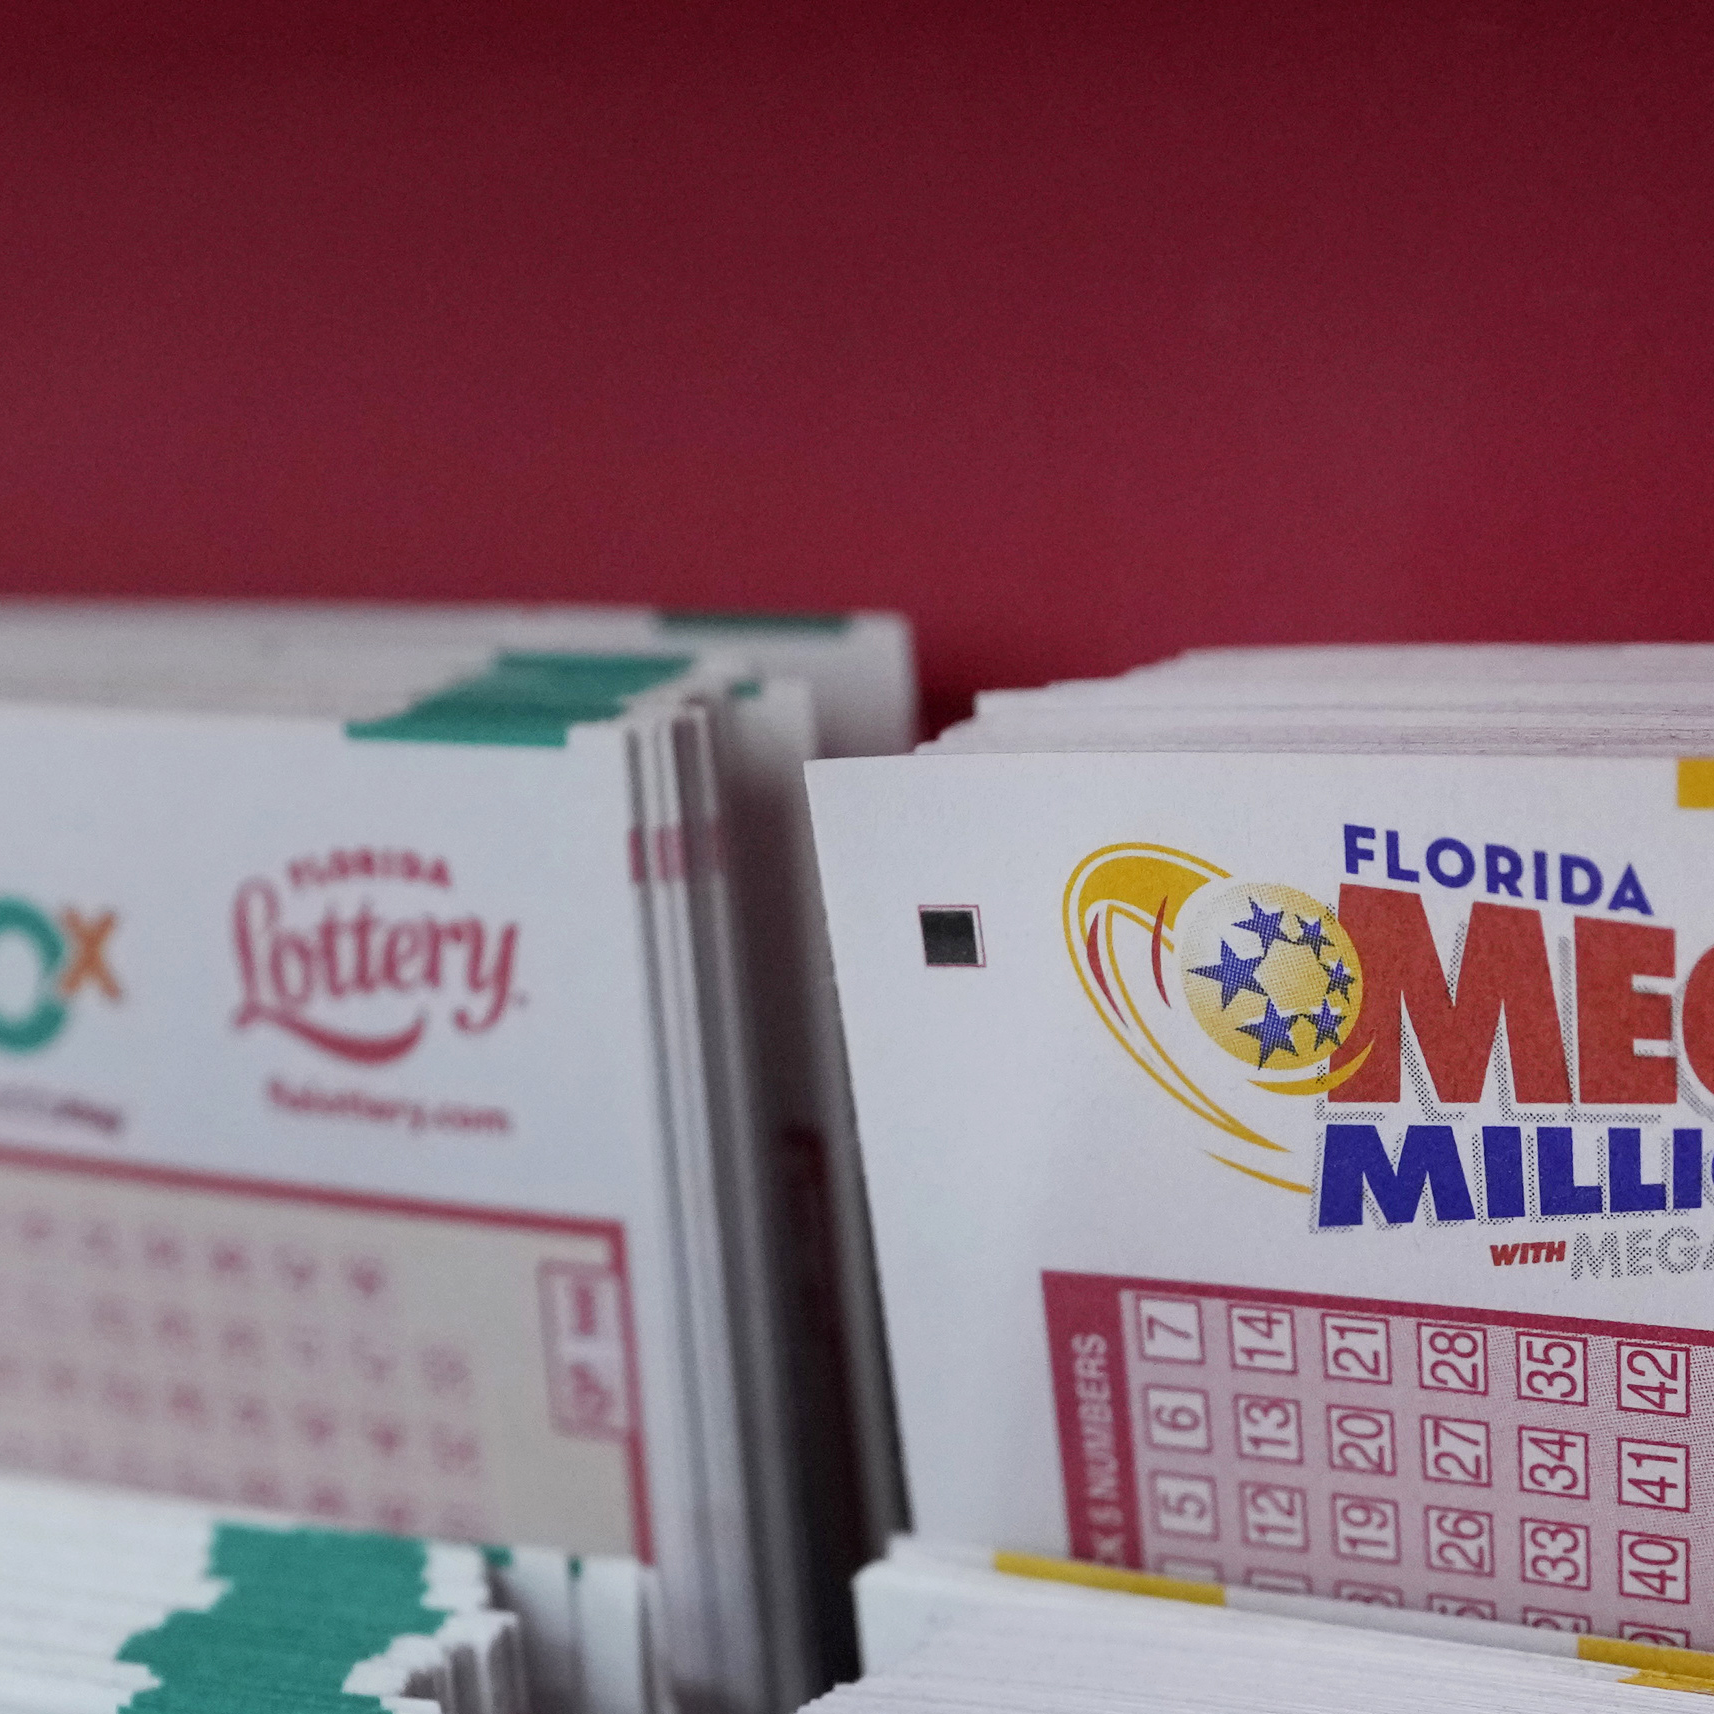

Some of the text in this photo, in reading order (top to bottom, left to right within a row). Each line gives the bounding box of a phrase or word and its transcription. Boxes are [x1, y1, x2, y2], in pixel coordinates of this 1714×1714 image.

[288, 848, 452, 890] FLORIDA
[1343, 823, 1653, 918] FLORIDA
[231, 876, 517, 1066] Lottery
[1490, 1238, 1567, 1266] WITH
[1144, 1314, 1201, 1433] 6 7
[1237, 1310, 1297, 1538] 12 13 14
[1626, 1351, 1679, 1405] 42
[1331, 1324, 1389, 1550] 19 20 21
[1428, 1332, 1484, 1568] 26 27 28
[1525, 1341, 1580, 1580] 33 34 35
[1627, 1451, 1677, 1500] 41
[1627, 1540, 1679, 1592] 40
